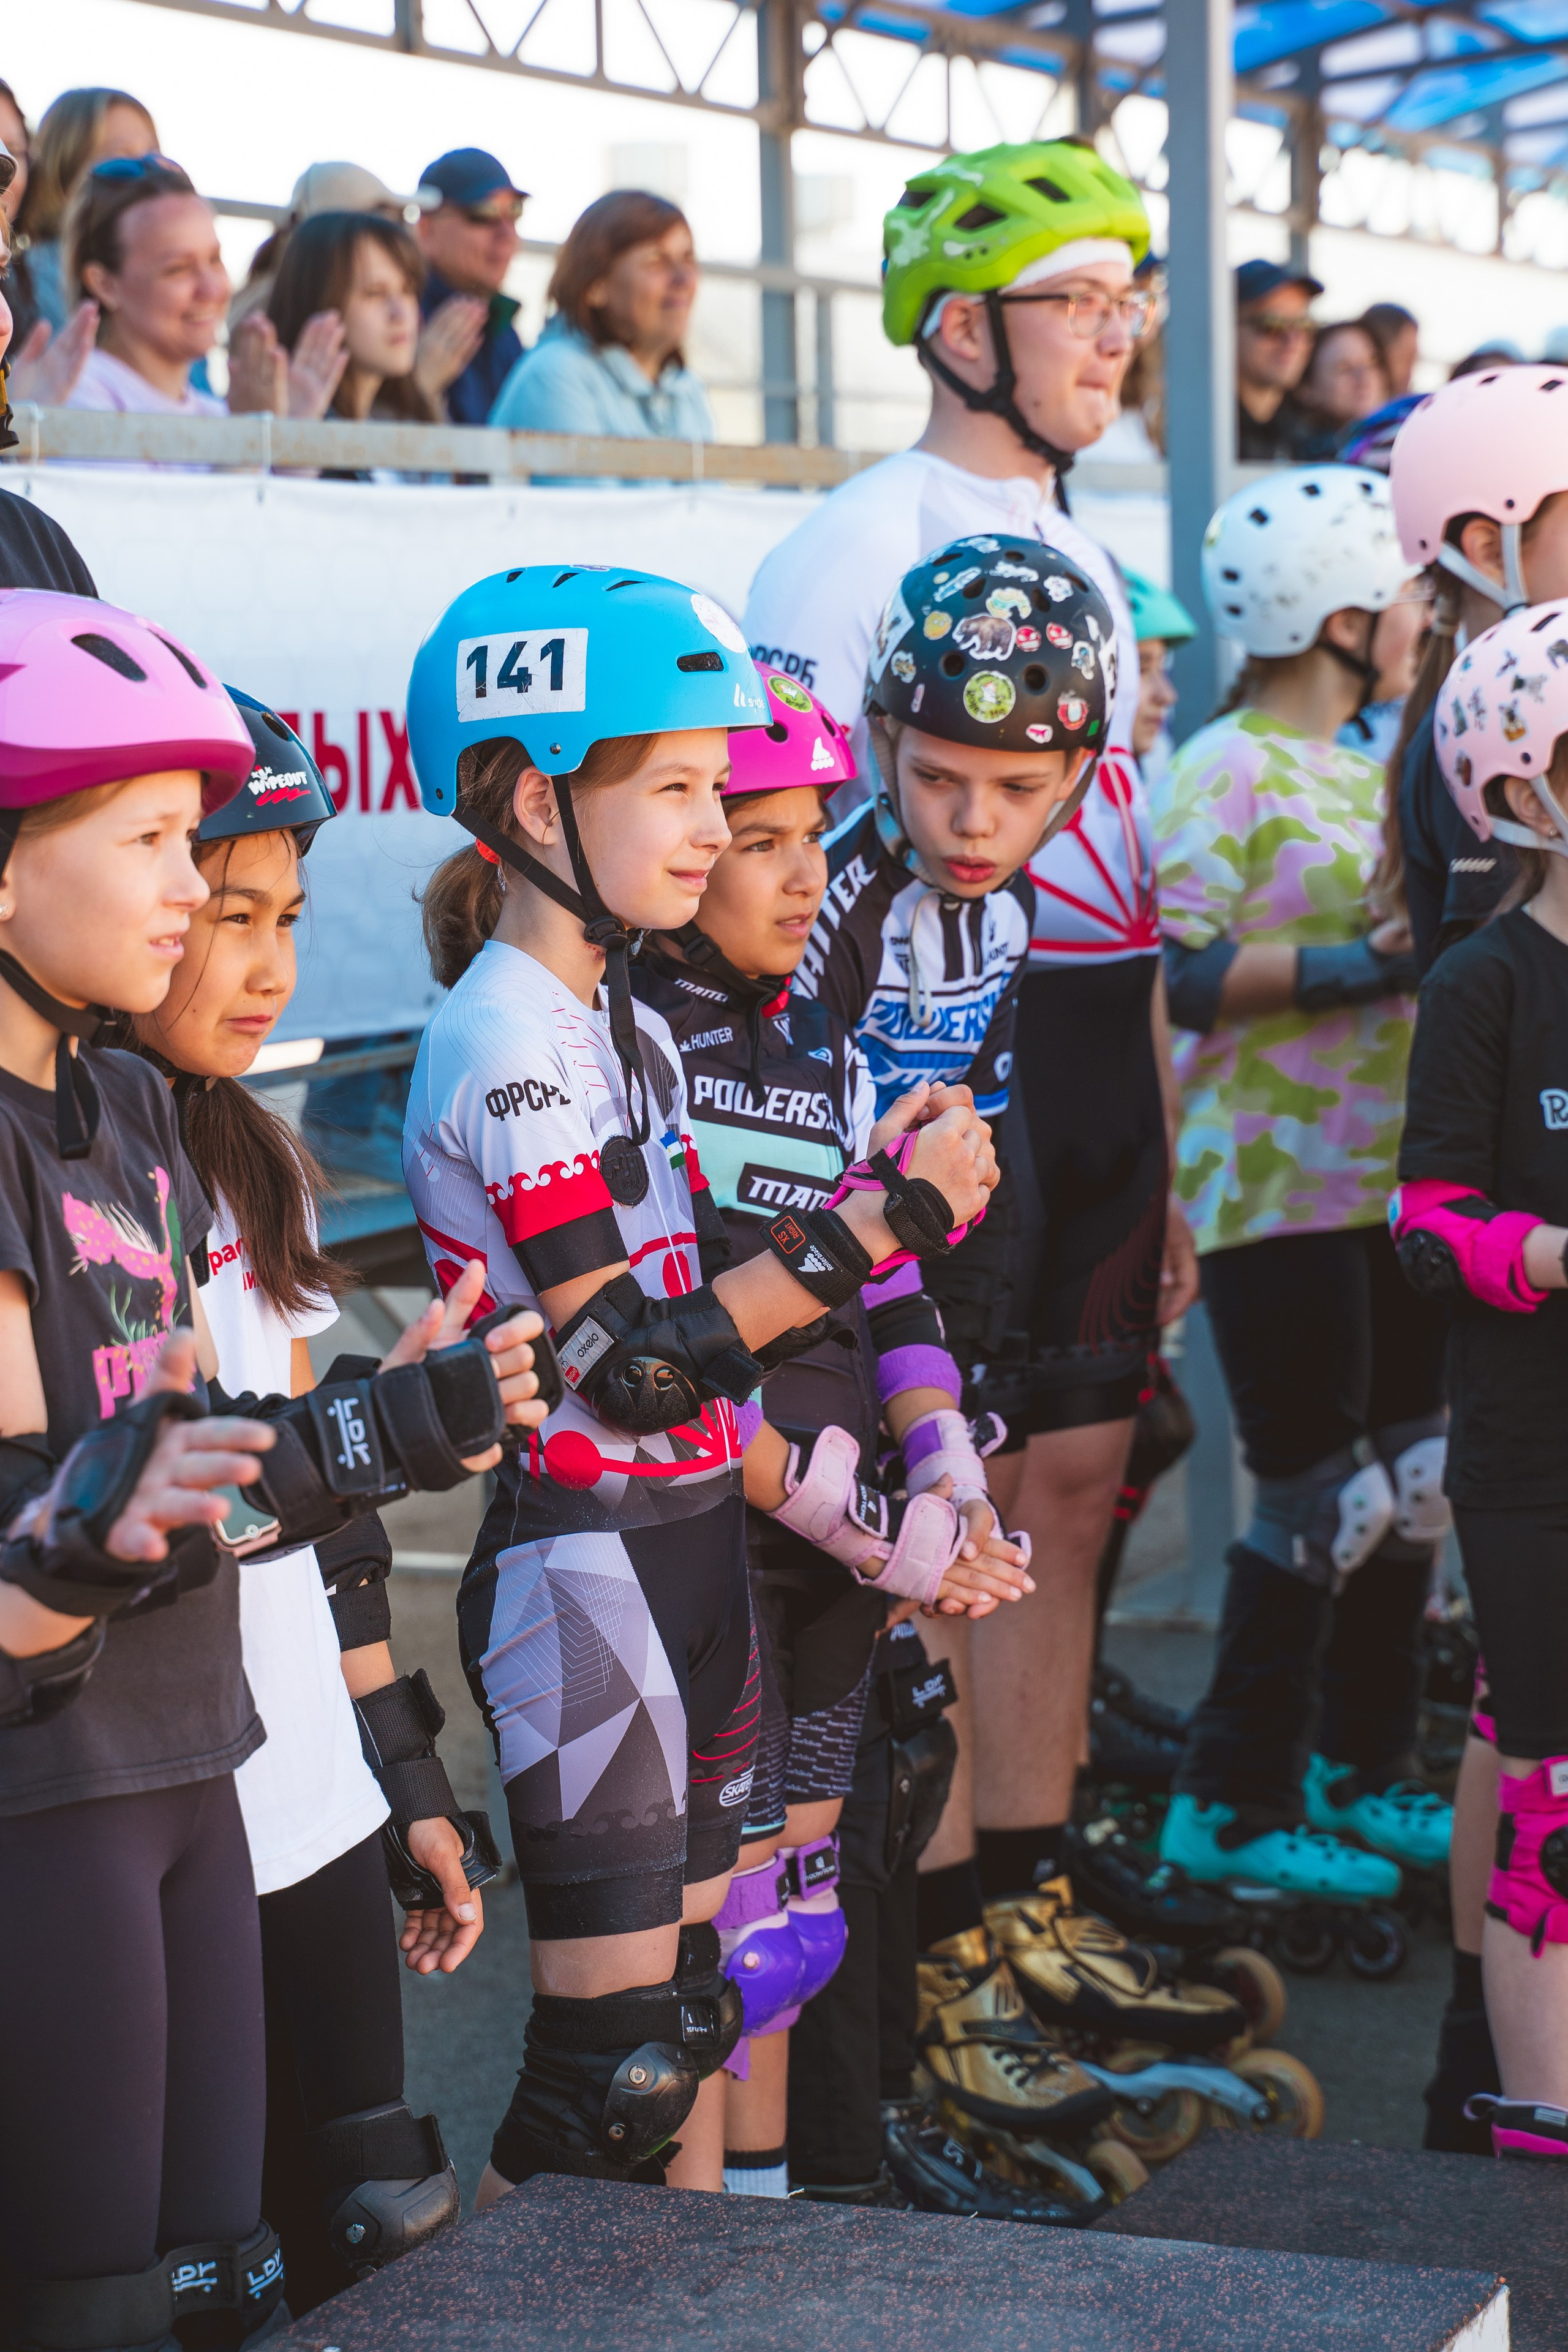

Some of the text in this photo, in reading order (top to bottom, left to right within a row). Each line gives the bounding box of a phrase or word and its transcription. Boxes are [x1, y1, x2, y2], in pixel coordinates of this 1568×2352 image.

[466, 638, 565, 699] 141
[247, 771, 308, 796] WIPEOUT
[690, 1026, 734, 1050] HUNTER
[778, 1231, 790, 1244] XS
[784, 1222, 800, 1240] RIGHT
[809, 1245, 834, 1272] Rollerblade
[577, 1333, 599, 1358] oxelo
